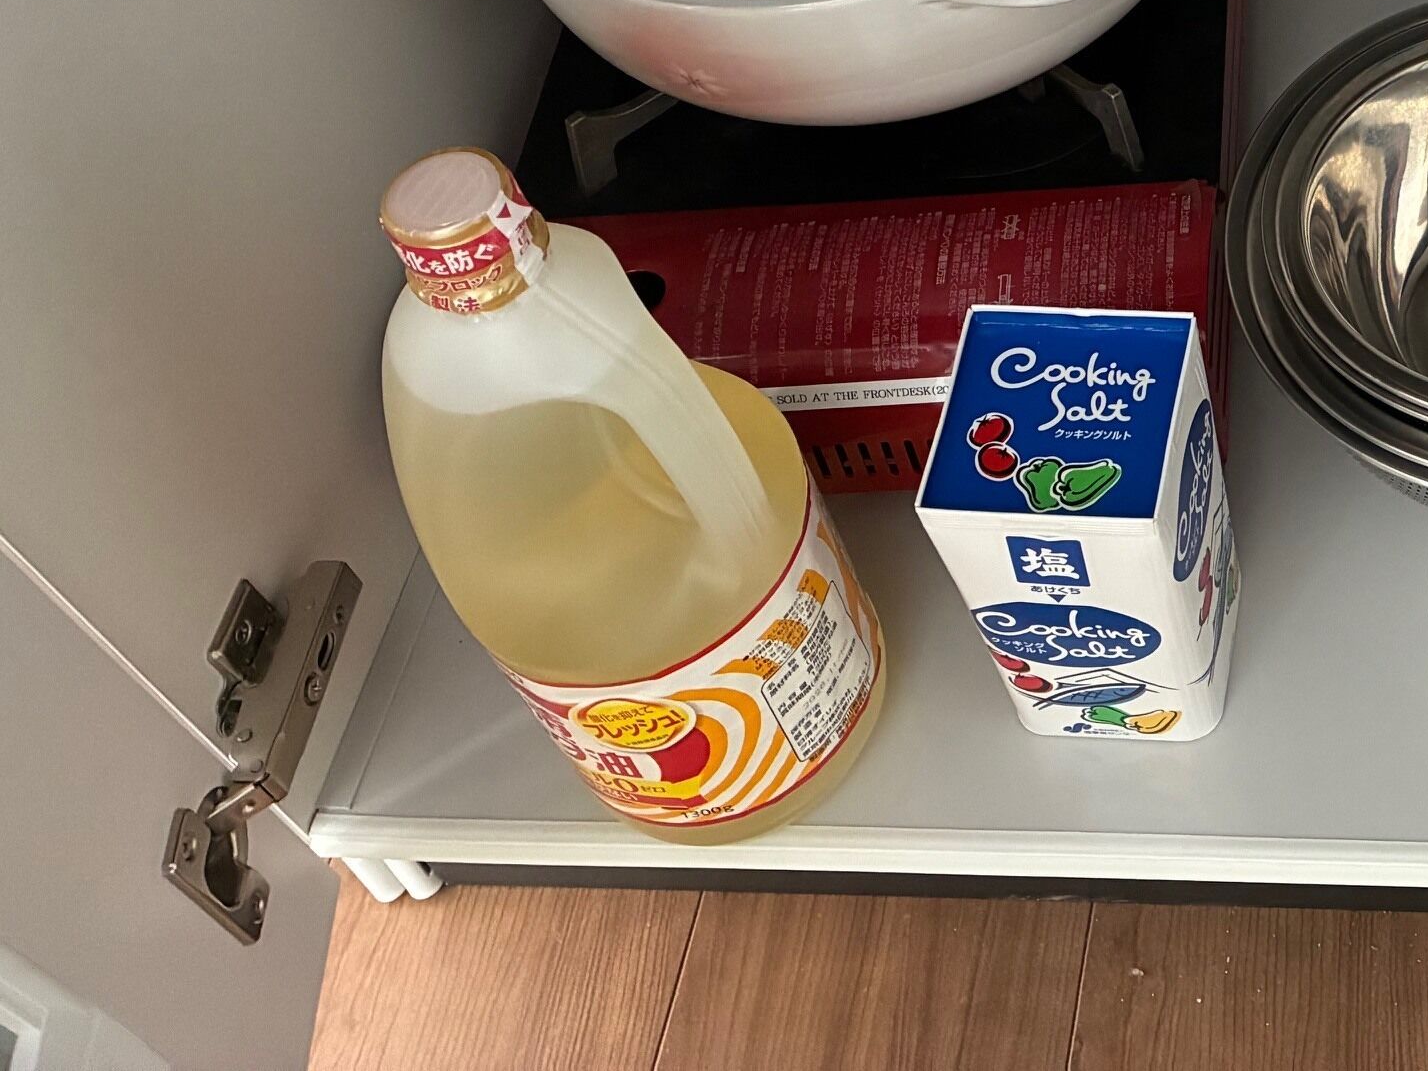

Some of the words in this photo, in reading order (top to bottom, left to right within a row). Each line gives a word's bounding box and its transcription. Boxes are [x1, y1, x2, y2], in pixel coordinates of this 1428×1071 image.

[990, 346, 1156, 401] Cooking
[777, 394, 807, 404] SOLD
[812, 392, 829, 402] AT
[834, 390, 859, 401] THE
[1038, 383, 1131, 431] Salt
[1054, 429, 1132, 441] クッキングソルト
[1020, 547, 1081, 580] 塩
[1031, 585, 1081, 595] あけくち
[975, 610, 1150, 647] Cooking
[991, 637, 1046, 650] クッキング
[1014, 643, 1048, 654] ソルト
[1048, 635, 1136, 661] Salt
[582, 709, 686, 739] フレッシュ!
[681, 805, 735, 818] 1300g
